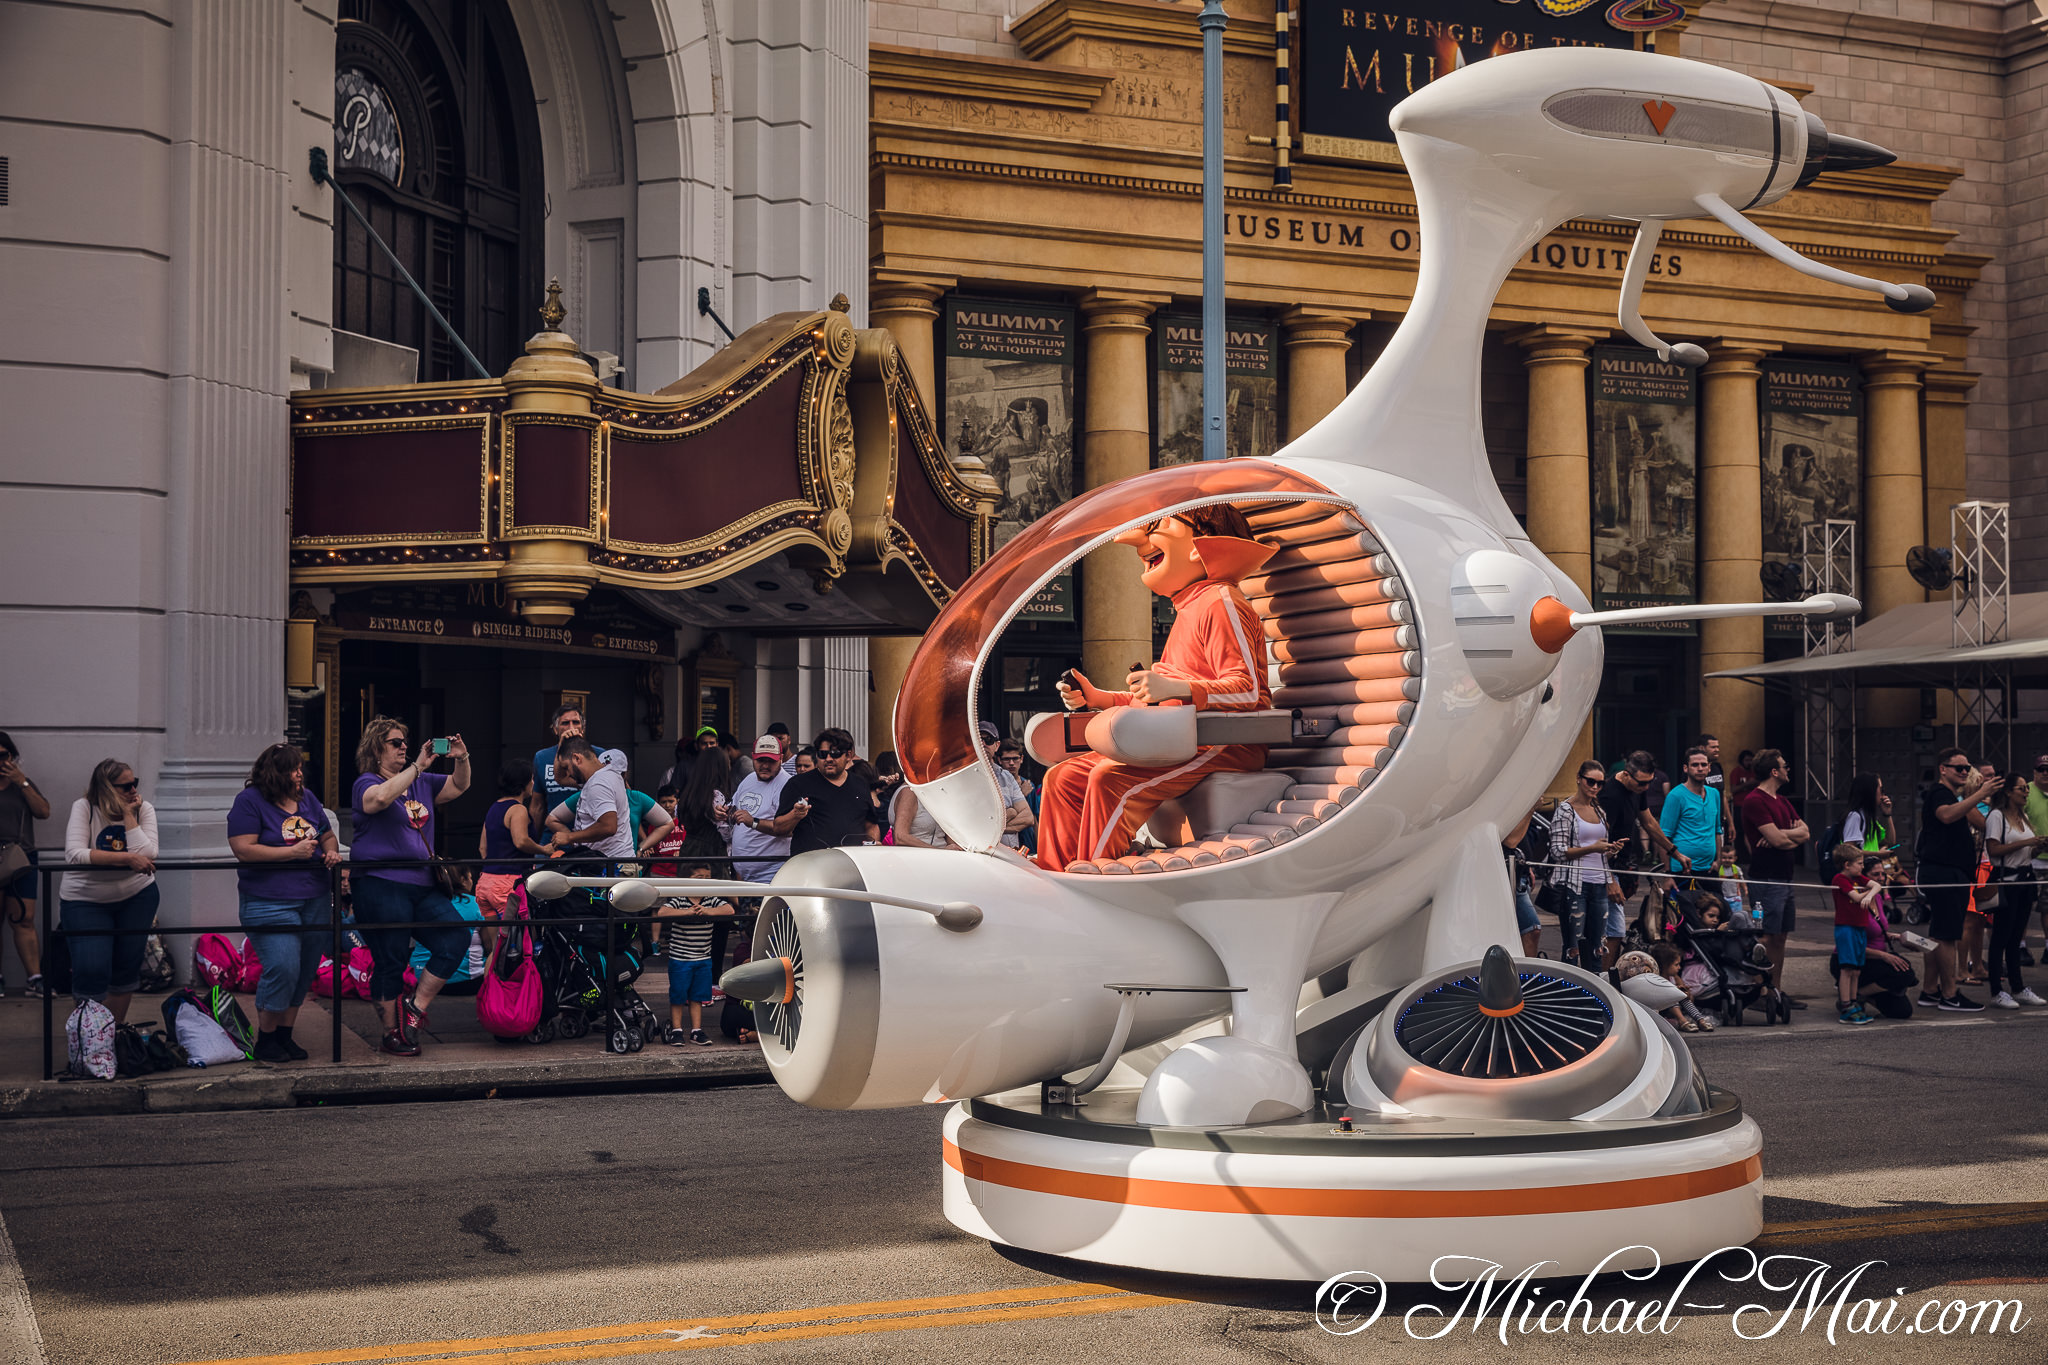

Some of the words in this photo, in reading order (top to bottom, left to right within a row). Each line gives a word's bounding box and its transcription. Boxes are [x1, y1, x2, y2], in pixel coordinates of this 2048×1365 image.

[1341, 8, 1484, 45] REVENGE
[1501, 30, 1534, 49] OF
[1390, 229, 1420, 252] O
[1525, 243, 1682, 277] IQUITES
[956, 311, 1065, 332] MUMMY
[977, 334, 1003, 343] THE
[1007, 337, 1065, 348] MUSEUM
[1166, 326, 1269, 346] MUMY
[959, 342, 976, 350] OF
[980, 344, 1062, 356] ANTIQUITIES
[1187, 349, 1203, 357] TH
[1225, 352, 1269, 362] USEUM
[1169, 356, 1187, 364] OF
[1189, 358, 1267, 370] ANUITIES
[1601, 360, 1686, 377] MUMMY
[1768, 371, 1851, 388] MUMMY
[1603, 386, 1617, 394] OF
[1619, 388, 1687, 399] ANTIQUITIES
[1642, 382, 1689, 392] MUSEUM
[1807, 393, 1852, 402] MUSEUM
[1786, 400, 1850, 410] ANTIQUITIES
[1051, 583, 1064, 592] &
[1036, 593, 1056, 602] OF
[1603, 599, 1626, 608] THE
[369, 616, 431, 633] ENTRANCE
[1772, 623, 1793, 631] THE
[482, 622, 522, 637] SINGLE
[524, 624, 563, 642] RIDERS
[608, 637, 650, 653] EXPRESS
